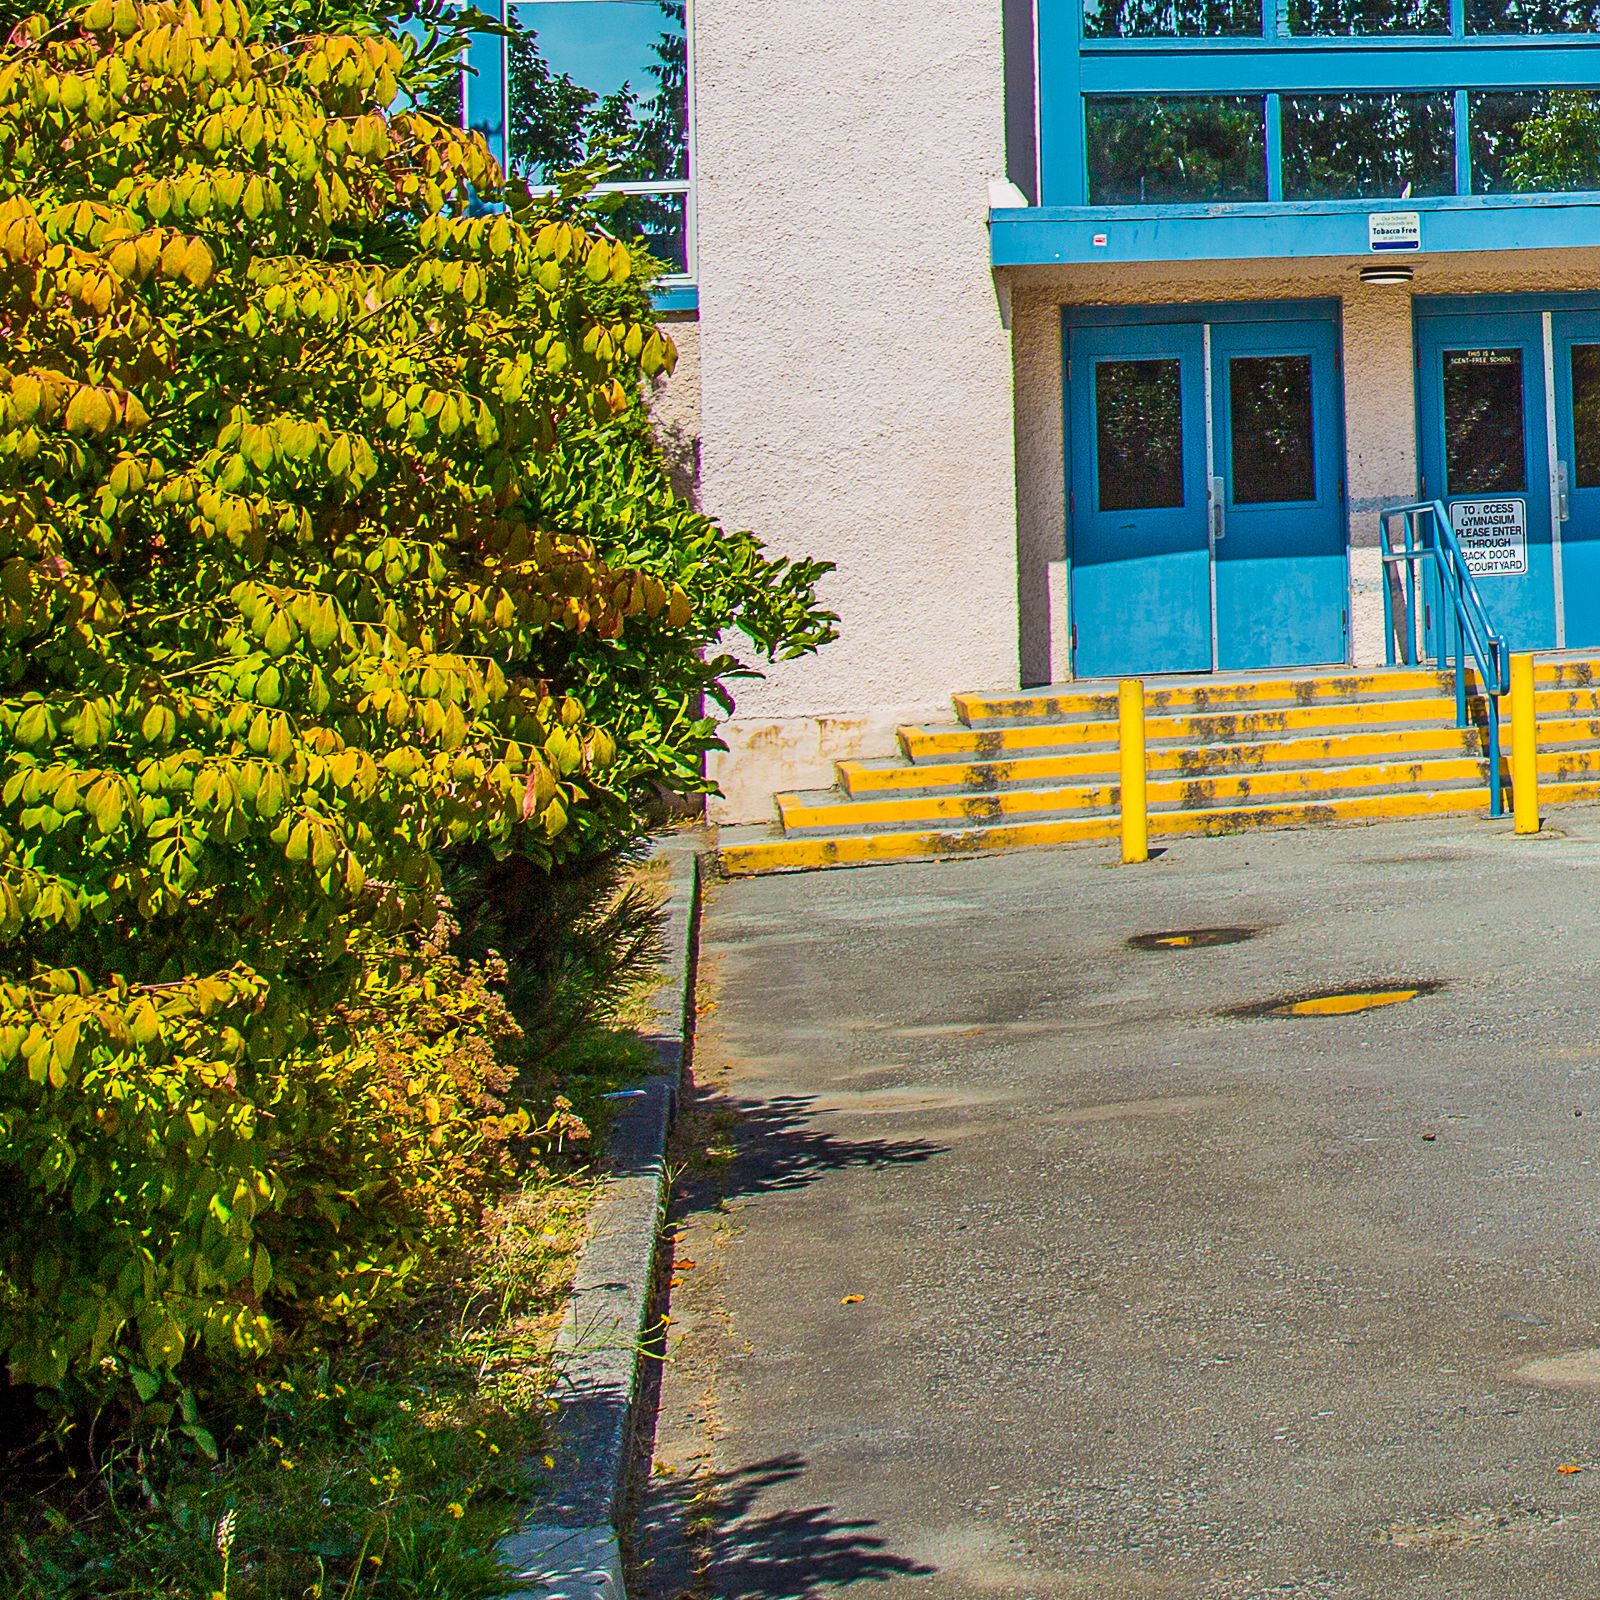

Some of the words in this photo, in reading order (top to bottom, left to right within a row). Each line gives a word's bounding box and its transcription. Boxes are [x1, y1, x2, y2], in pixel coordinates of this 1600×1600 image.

[1372, 227, 1400, 235] Tobacco
[1401, 226, 1418, 234] Free
[1462, 505, 1475, 515] TO
[1477, 504, 1514, 515] CCESS
[1461, 514, 1515, 526] GYMNASIUM
[1455, 527, 1490, 538] PLEASE
[1492, 526, 1522, 536] ENTER
[1467, 538, 1511, 549] THROUGH
[1461, 550, 1487, 561] BACK
[1489, 549, 1516, 559] DOOR
[1467, 560, 1523, 572] COURTYARD
